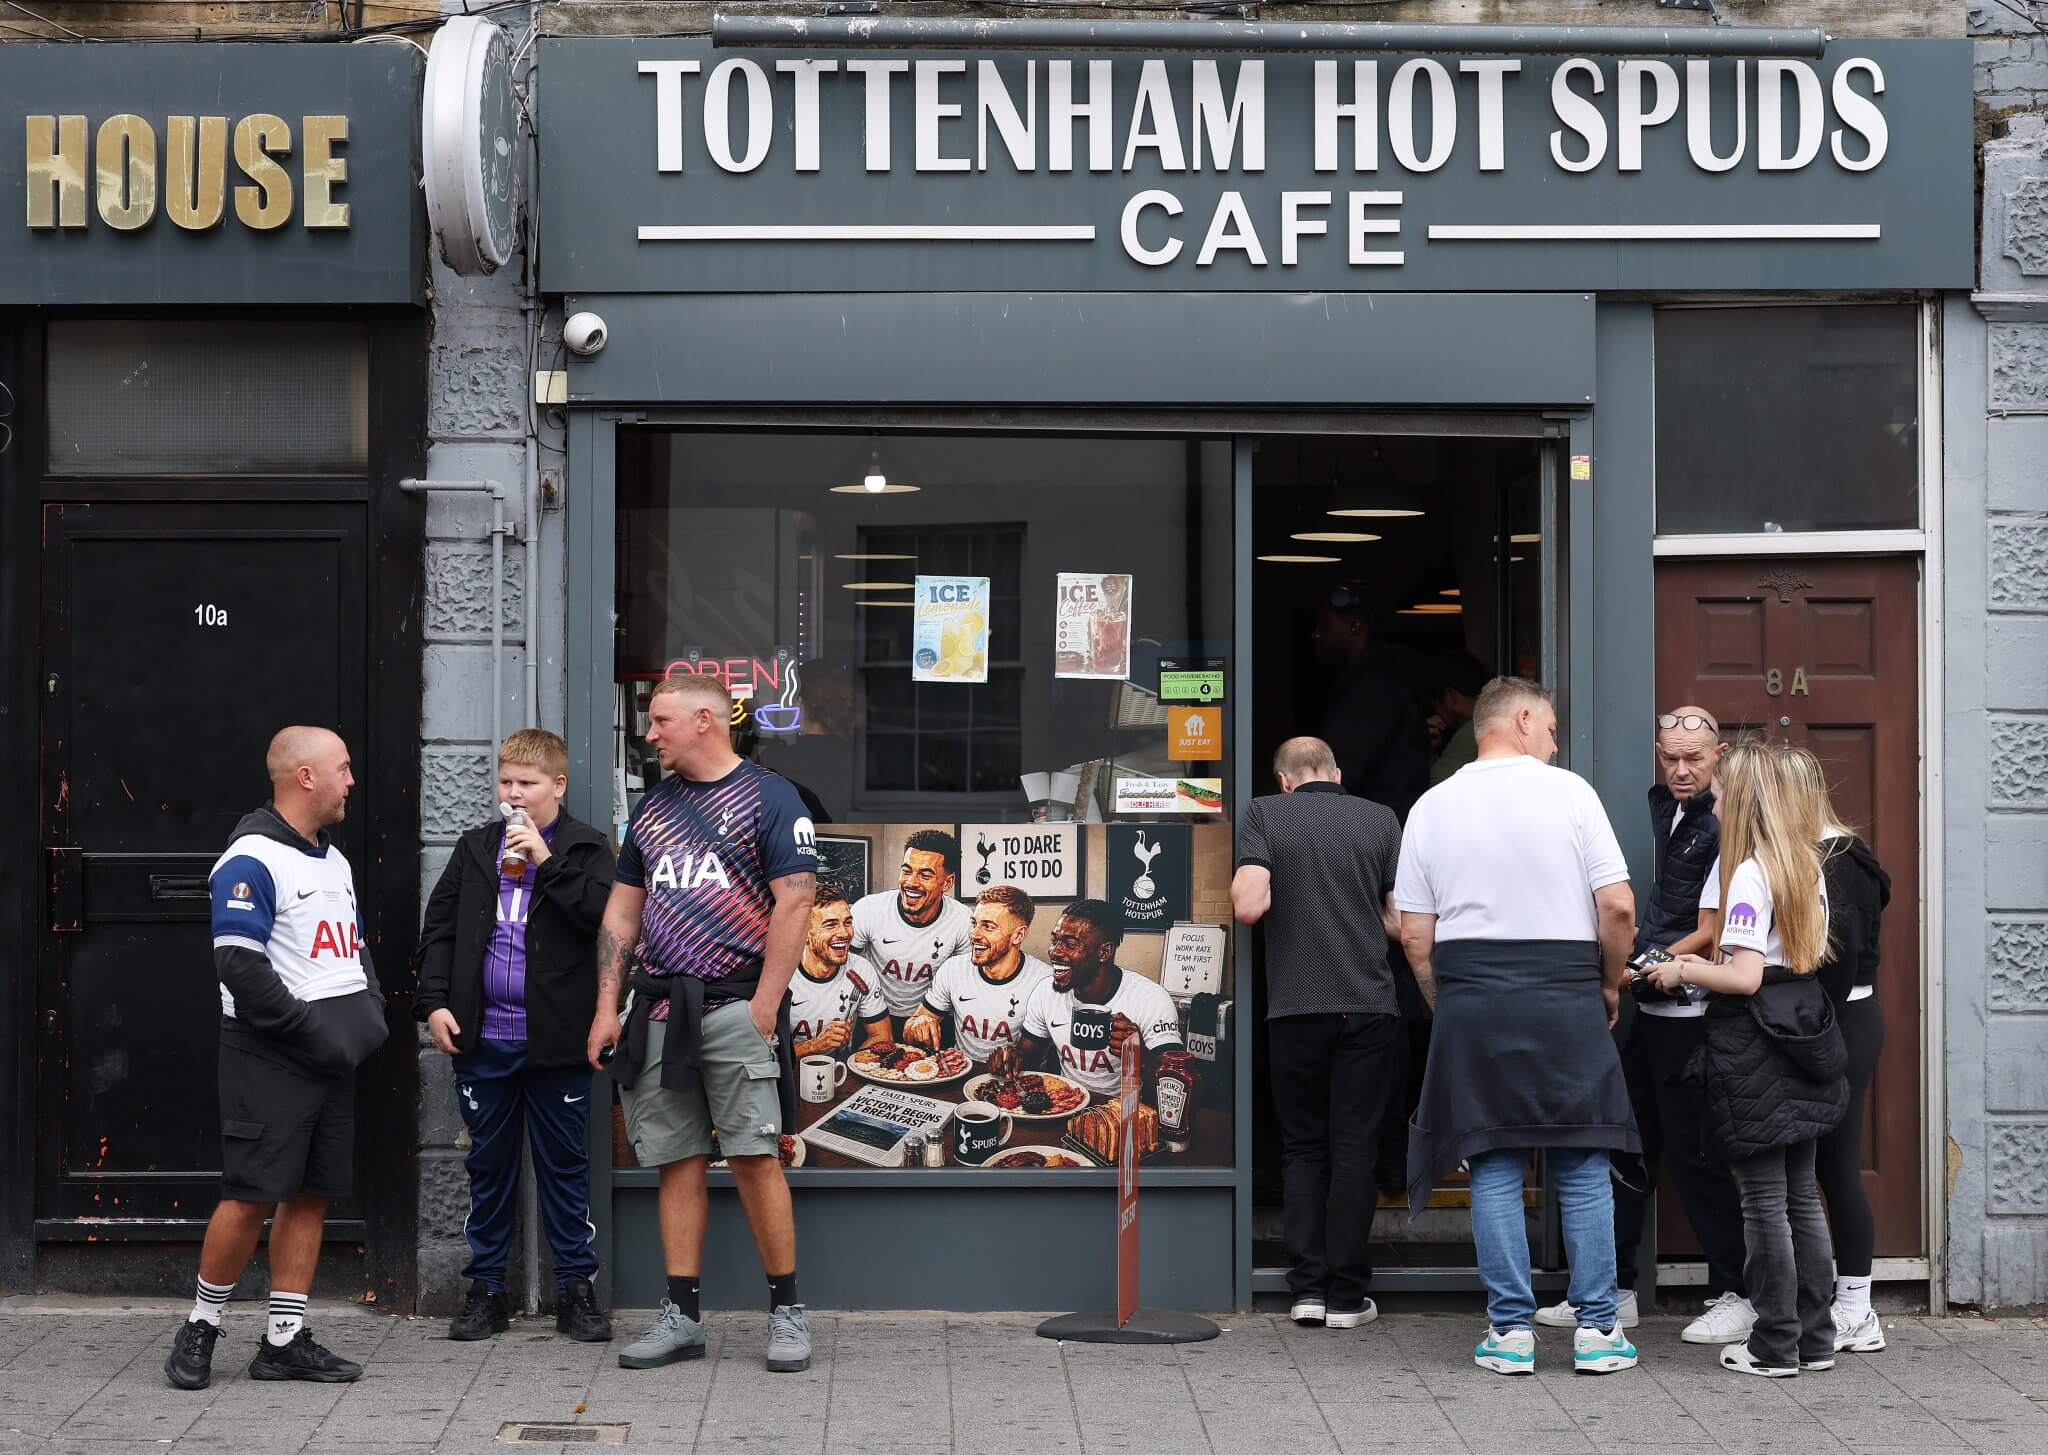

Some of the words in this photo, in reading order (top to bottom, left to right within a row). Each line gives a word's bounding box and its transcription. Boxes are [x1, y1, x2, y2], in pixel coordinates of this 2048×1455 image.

[638, 58, 1266, 172] TOTTENHAM
[1315, 58, 1521, 172] HOT
[1551, 58, 1888, 172] SPUDS
[26, 114, 350, 230] HOUSE
[1121, 190, 1405, 266] CAFE
[930, 585, 970, 603] ICE
[1060, 585, 1098, 602] ICE
[194, 603, 228, 626] 10a
[1179, 738, 1195, 746] JUST
[1002, 837, 1020, 855] TO
[1024, 834, 1062, 855] DARE
[652, 851, 731, 892] AIA
[1004, 861, 1016, 879] IS
[1020, 860, 1038, 879] TO
[1041, 859, 1063, 878] DO
[1121, 896, 1167, 913] TOTTENHAM
[1124, 909, 1165, 920] HOTSPUR
[1181, 933, 1206, 942] FOCUS
[1726, 927, 1755, 937] kraken
[1174, 954, 1192, 962] TEAM
[882, 959, 933, 982] AIA
[1181, 964, 1196, 972] WIN
[792, 1018, 842, 1041] AI
[961, 1014, 1013, 1042] AIA
[1073, 1021, 1104, 1039] COYS
[1188, 1039, 1214, 1055] COYS
[1061, 1044, 1115, 1074] AIA
[1162, 1081, 1180, 1093] HEINZ
[880, 1090, 909, 1101] DAILY
[910, 1097, 937, 1108] SPURS
[847, 1102, 863, 1111] AT
[861, 1106, 927, 1128] BREAKFAST
[855, 1095, 903, 1113] VICTORY
[902, 1107, 942, 1123] BEGINS
[972, 1136, 997, 1150] SPURS
